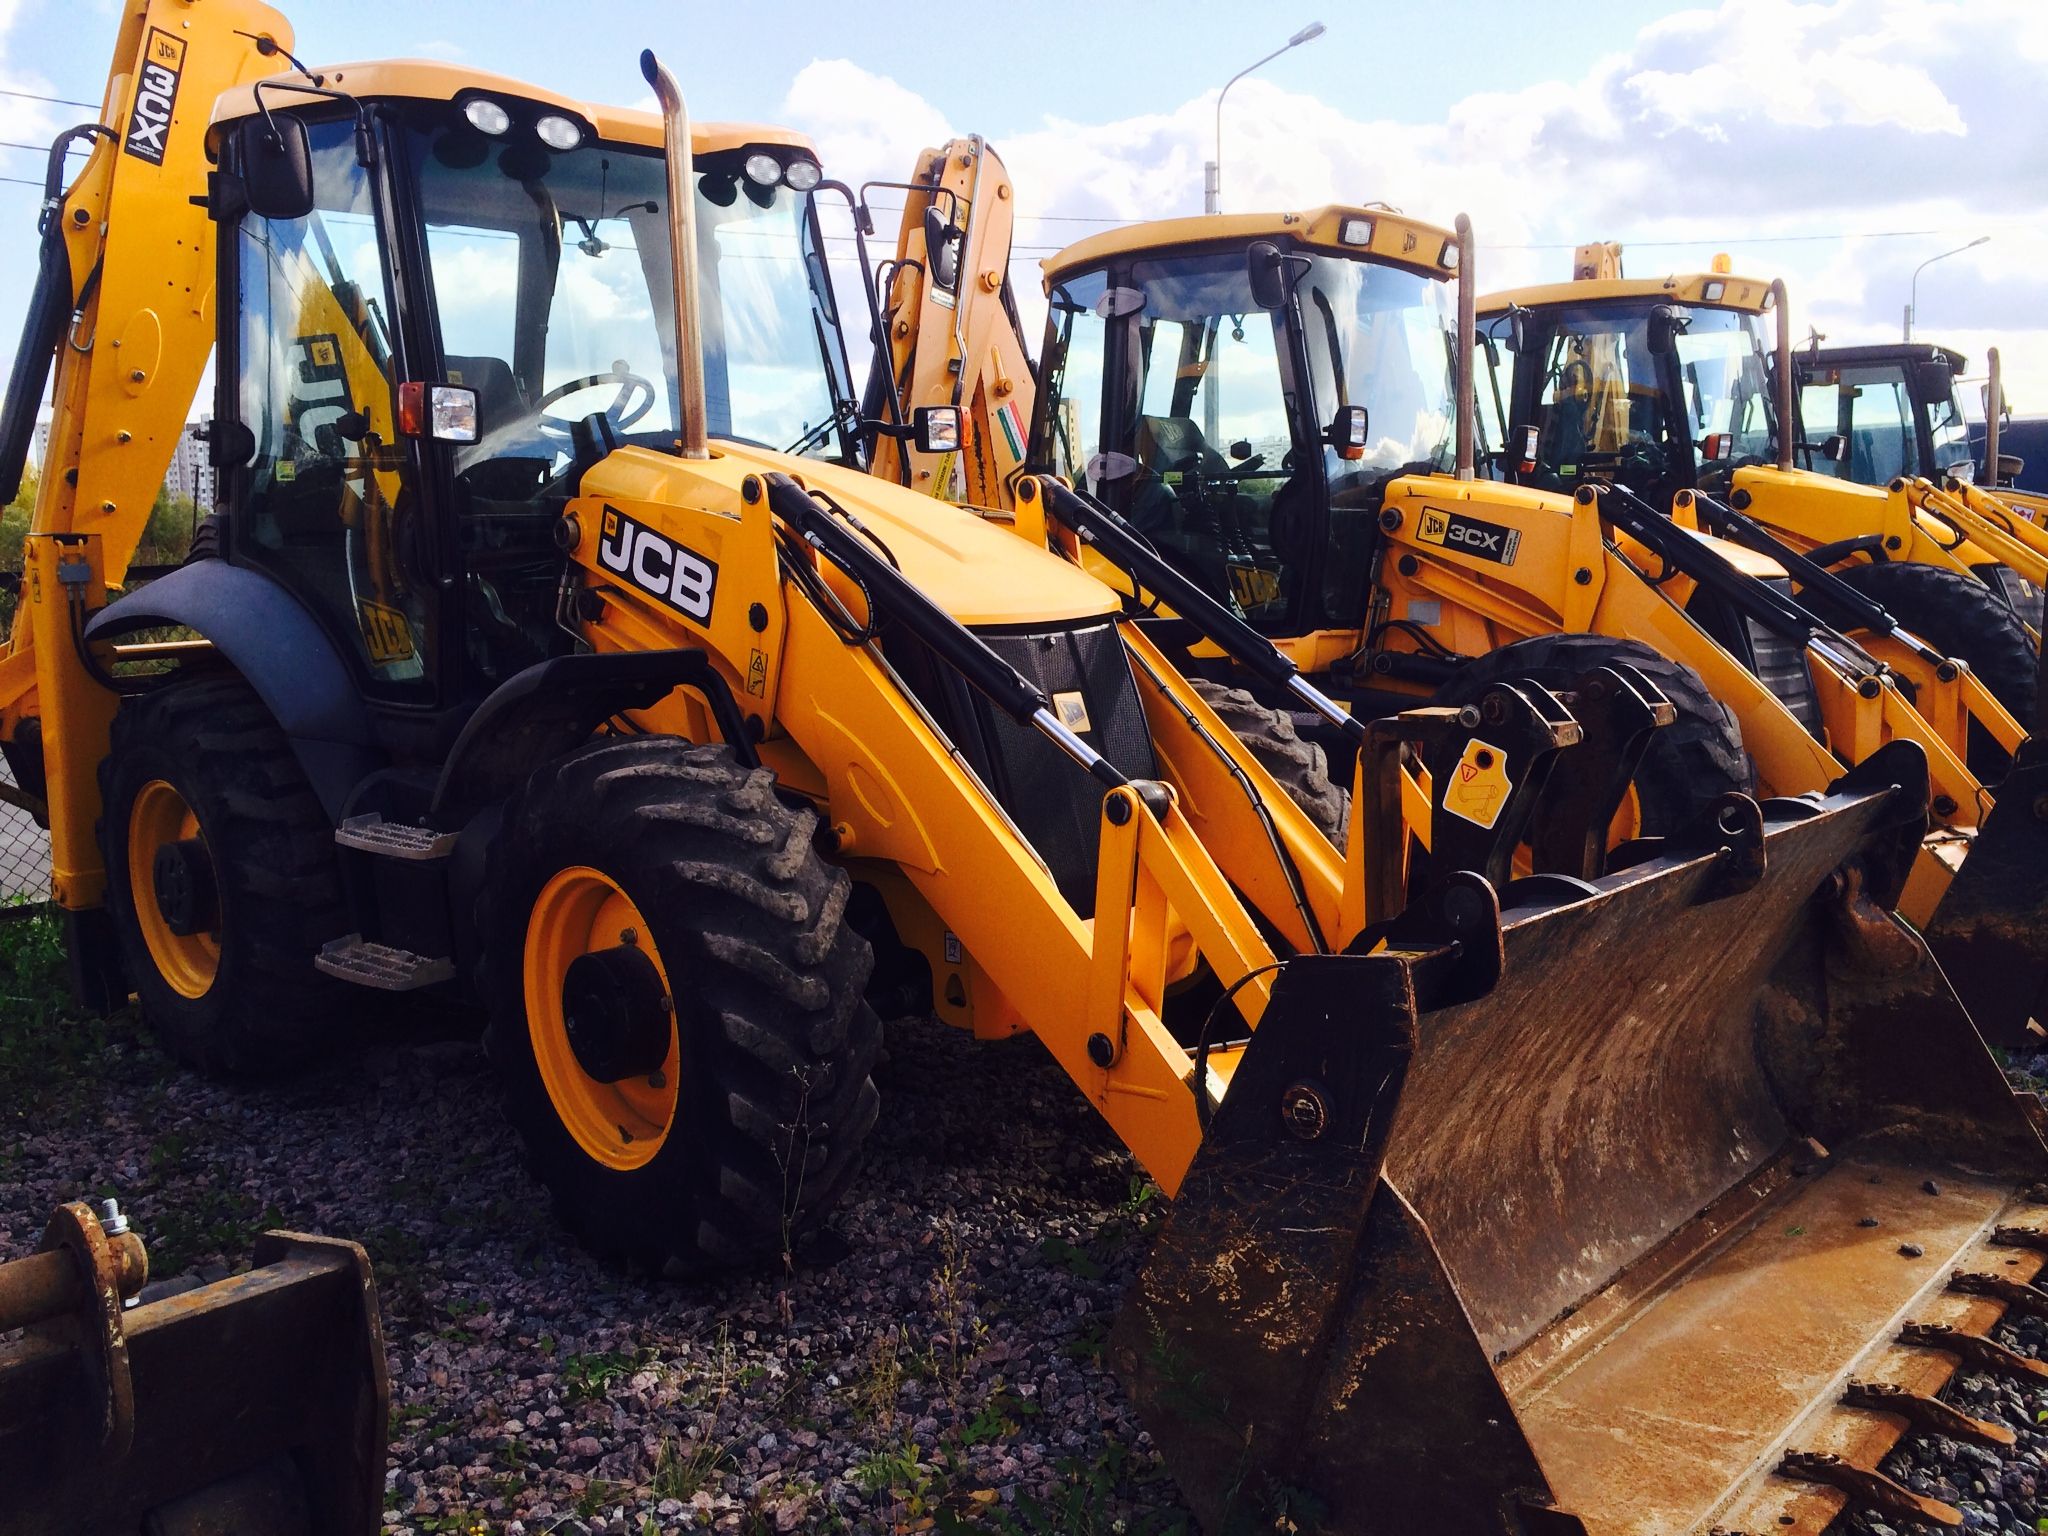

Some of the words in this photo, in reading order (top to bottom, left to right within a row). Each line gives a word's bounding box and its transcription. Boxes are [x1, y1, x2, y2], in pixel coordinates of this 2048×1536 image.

[159, 41, 176, 59] JCB
[129, 64, 175, 151] 3CX
[1427, 516, 1445, 534] JCB
[1448, 524, 1500, 552] 3CX
[602, 521, 713, 618] JCB
[363, 604, 411, 659] JCB
